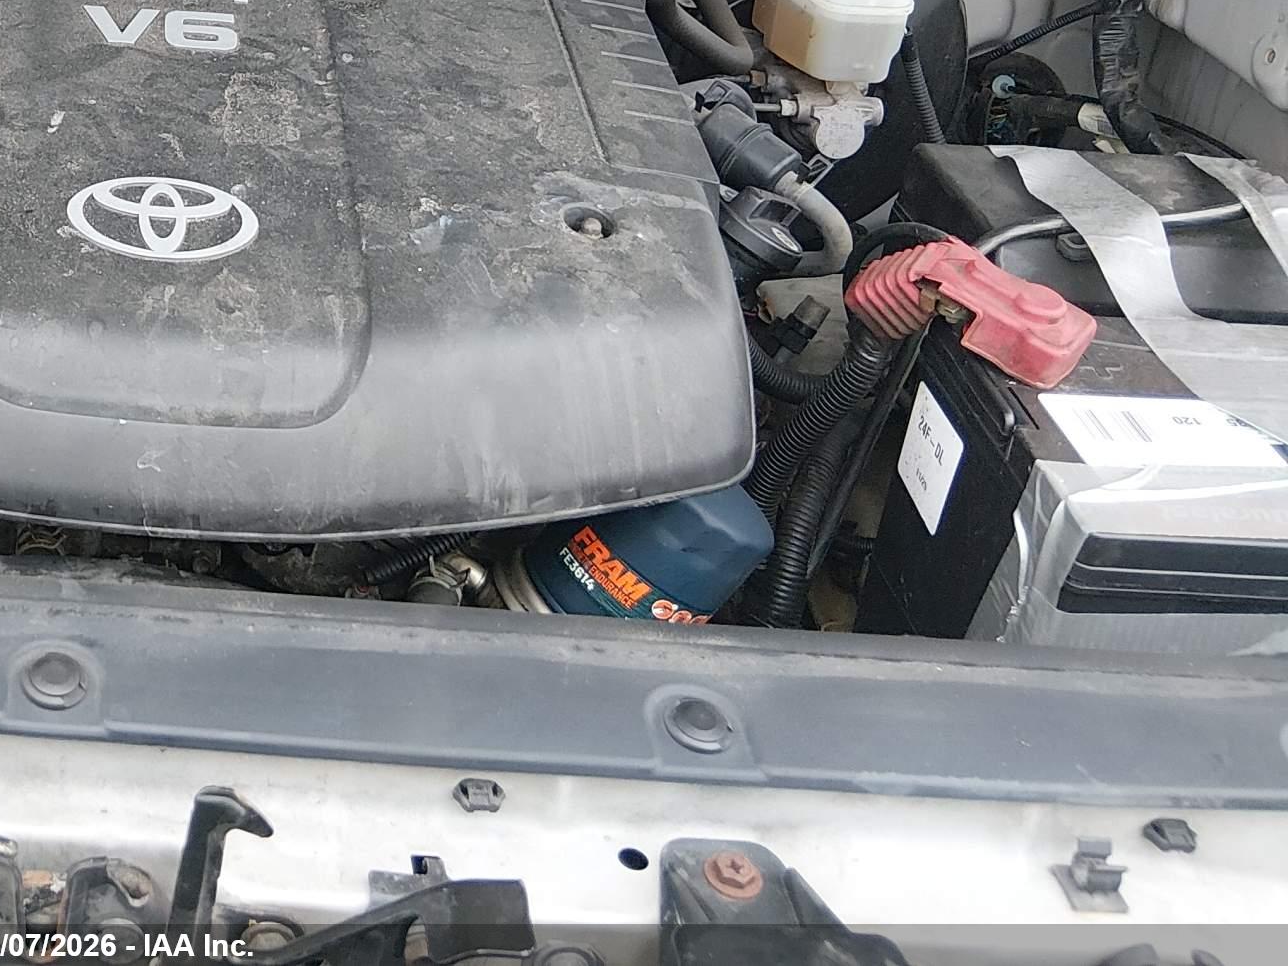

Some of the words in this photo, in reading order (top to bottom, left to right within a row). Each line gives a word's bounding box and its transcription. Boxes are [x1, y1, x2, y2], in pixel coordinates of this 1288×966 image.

[83, 4, 239, 51] V6
[1171, 416, 1202, 426] 120
[559, 546, 595, 591] FE3614
[573, 525, 653, 603] FRAM
